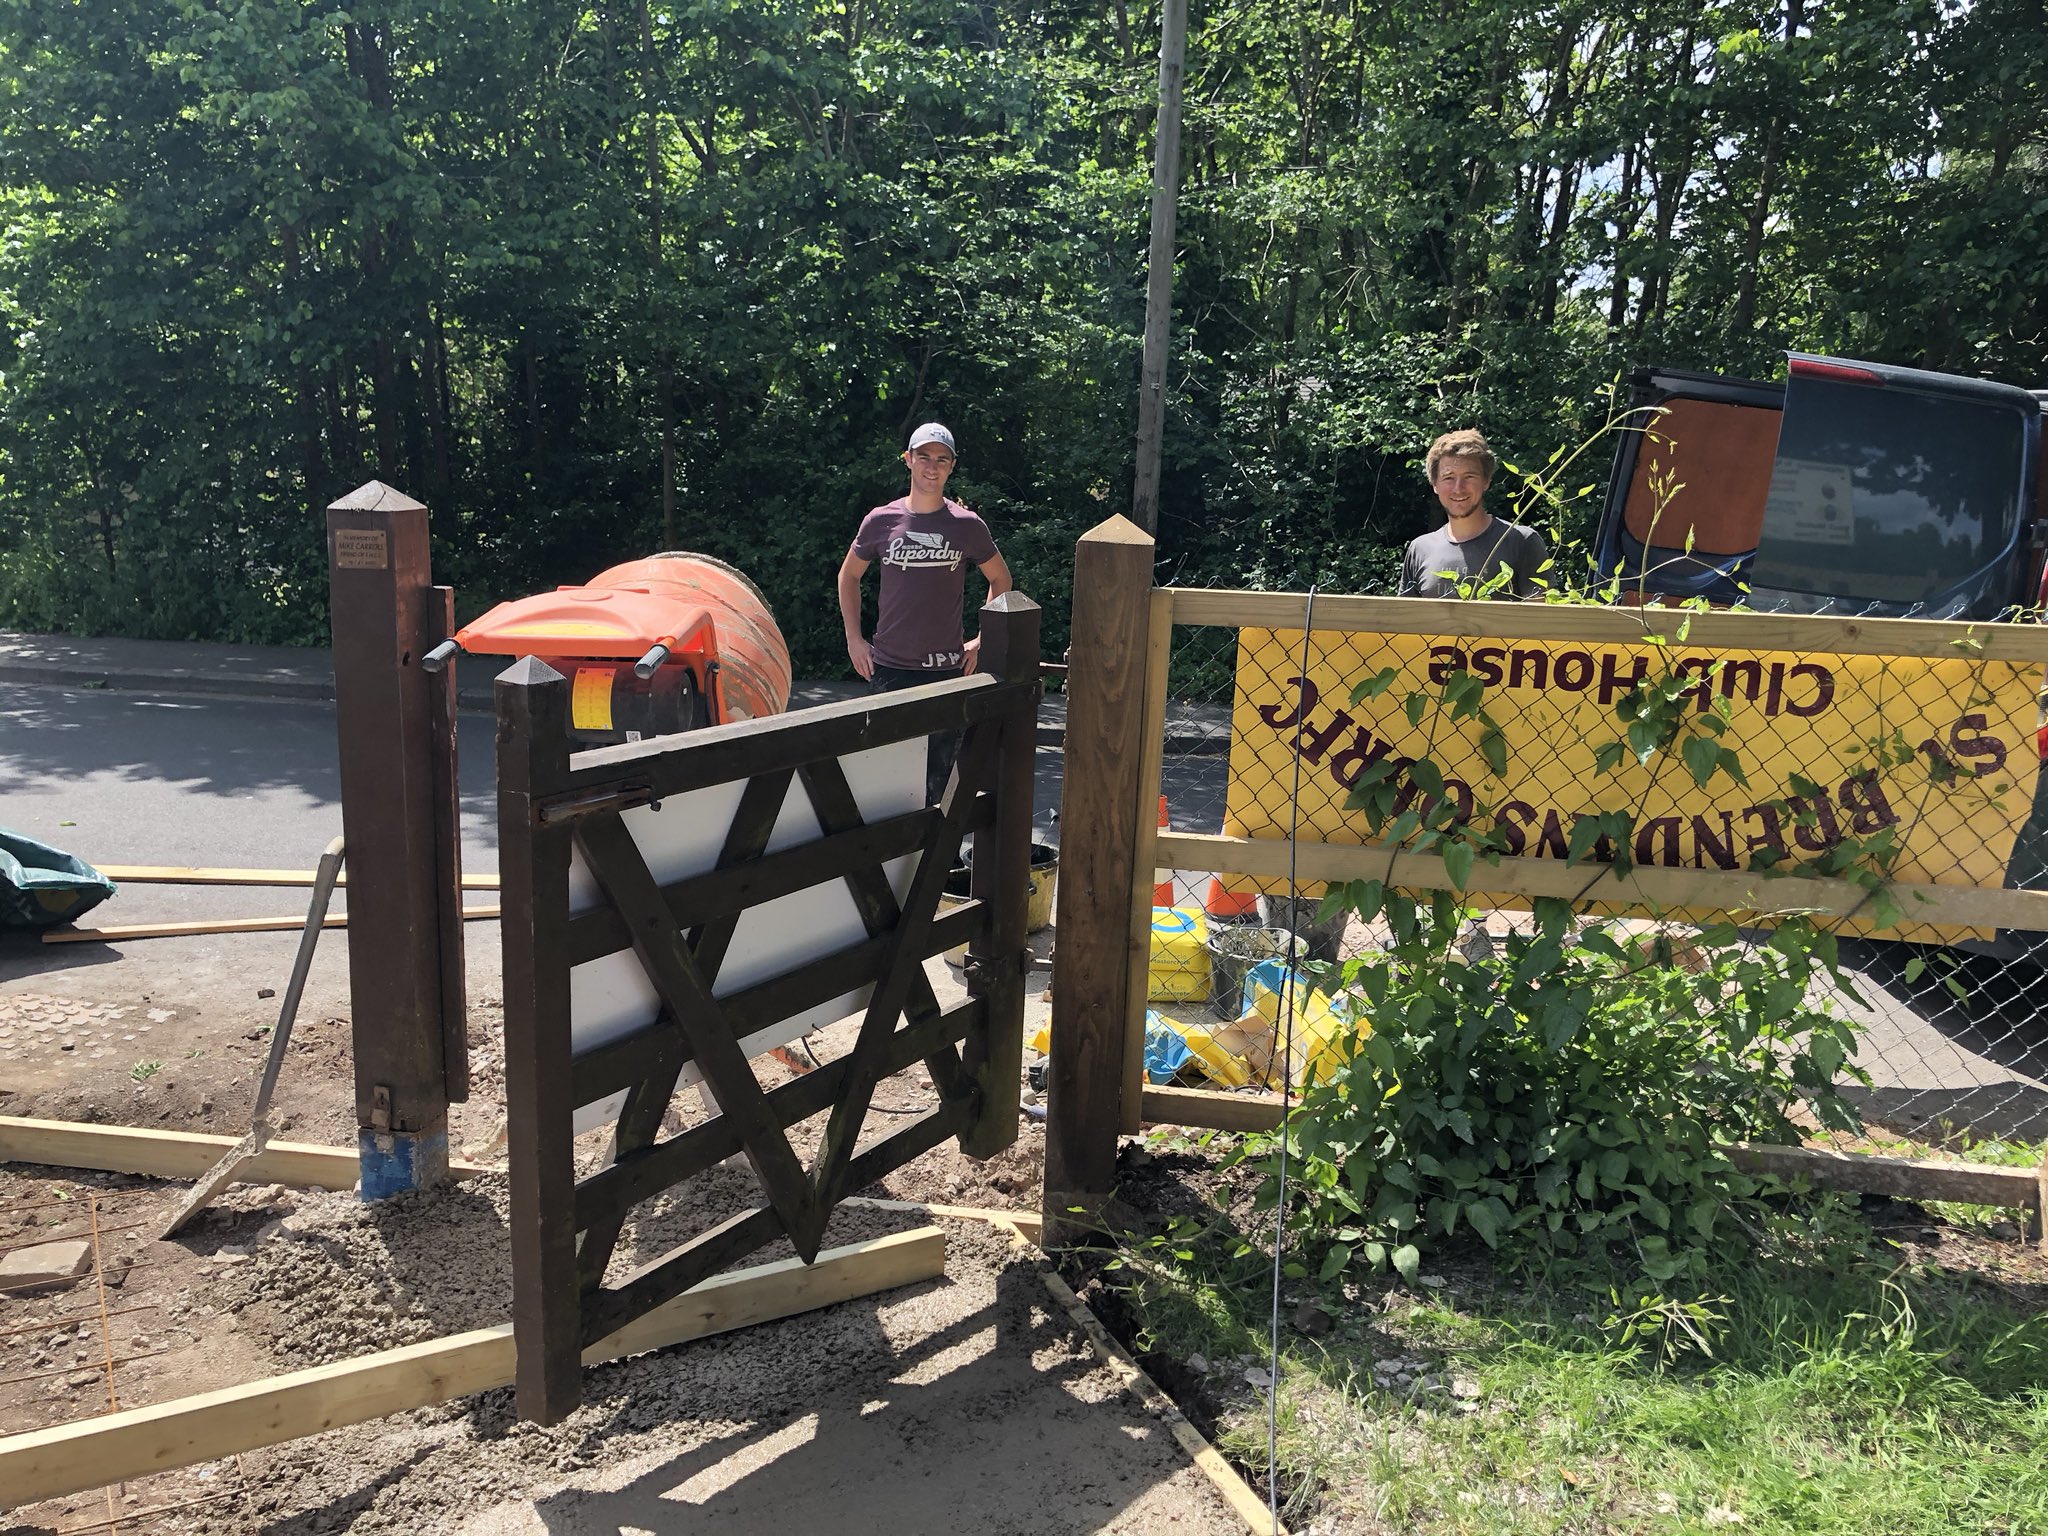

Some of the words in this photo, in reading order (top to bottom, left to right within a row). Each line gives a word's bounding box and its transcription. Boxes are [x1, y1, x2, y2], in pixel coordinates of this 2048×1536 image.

[882, 537, 962, 571] Superdry
[1428, 646, 1649, 705] House
[1674, 656, 1834, 717] Club
